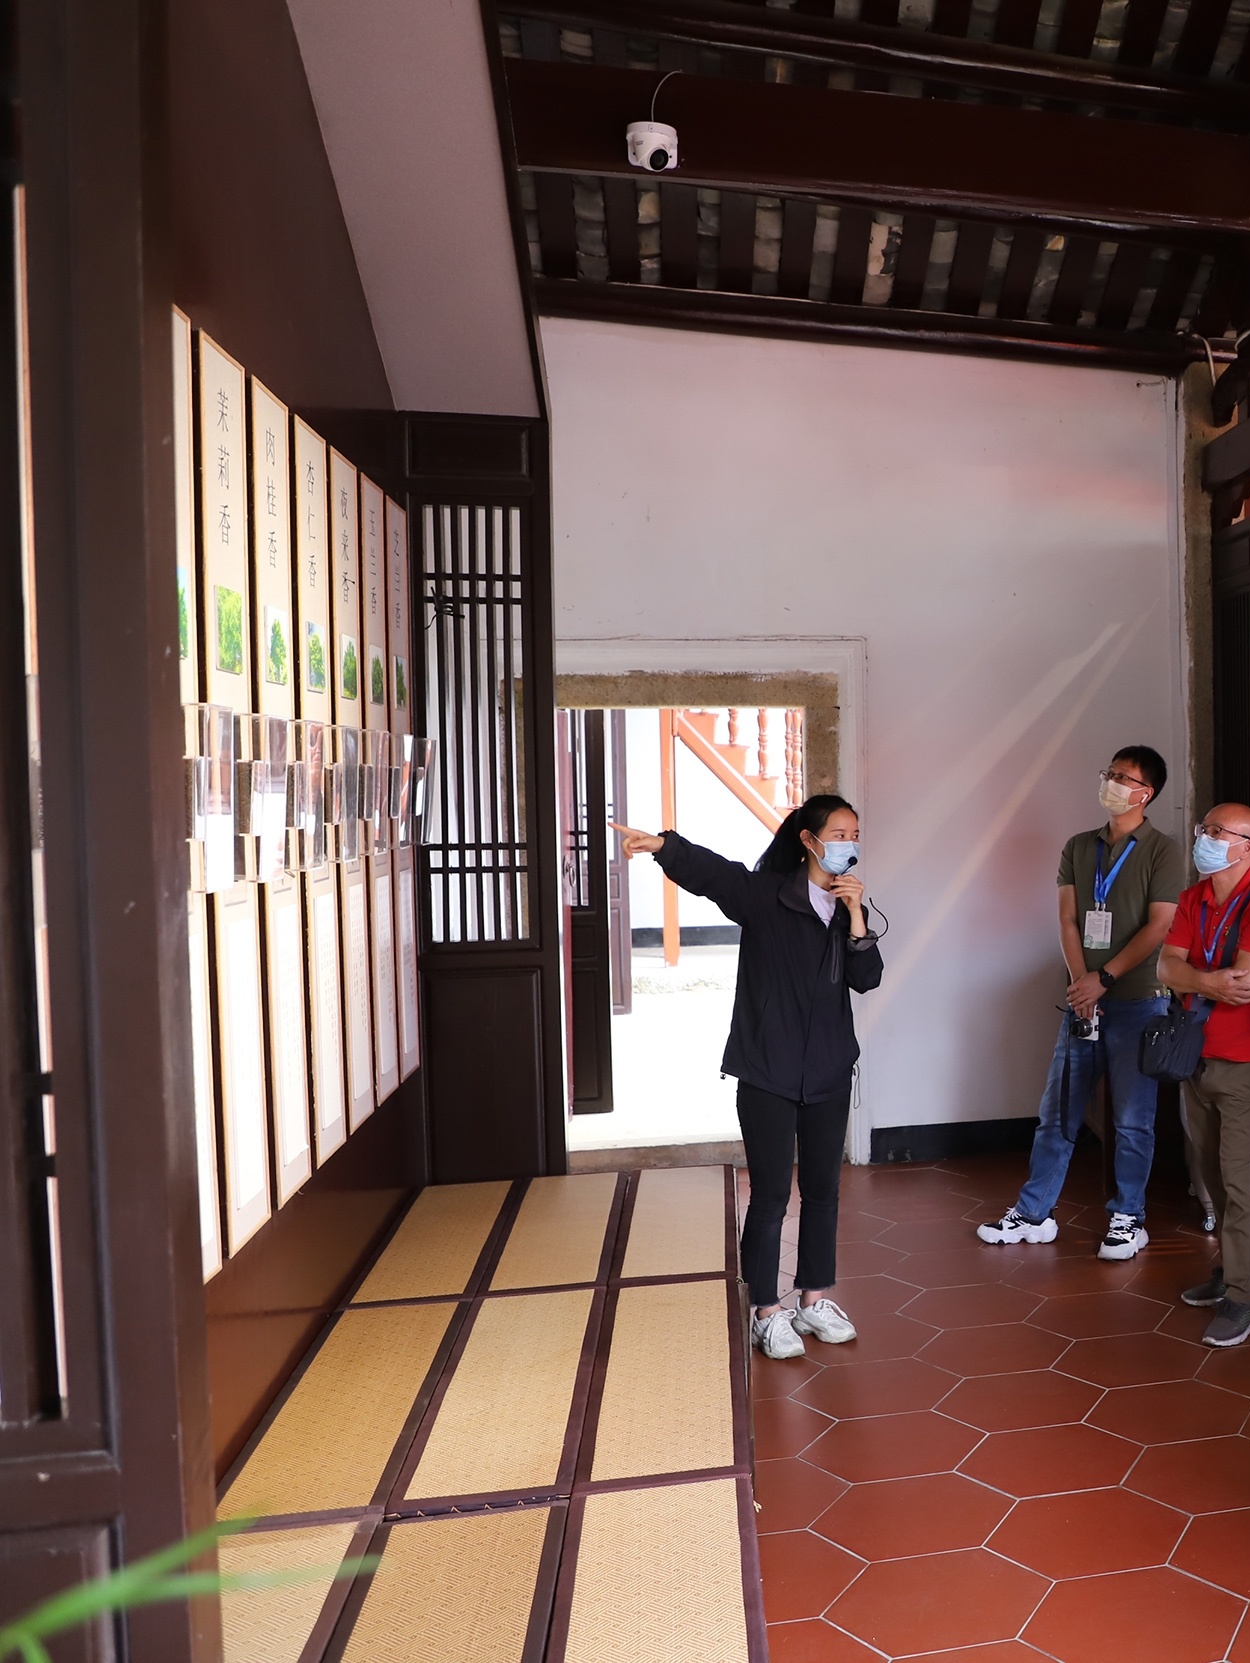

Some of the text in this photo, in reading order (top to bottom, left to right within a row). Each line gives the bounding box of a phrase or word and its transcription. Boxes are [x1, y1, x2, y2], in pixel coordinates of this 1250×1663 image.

[216, 388, 232, 546] 茉莉香
[264, 427, 278, 569] 肉桂香
